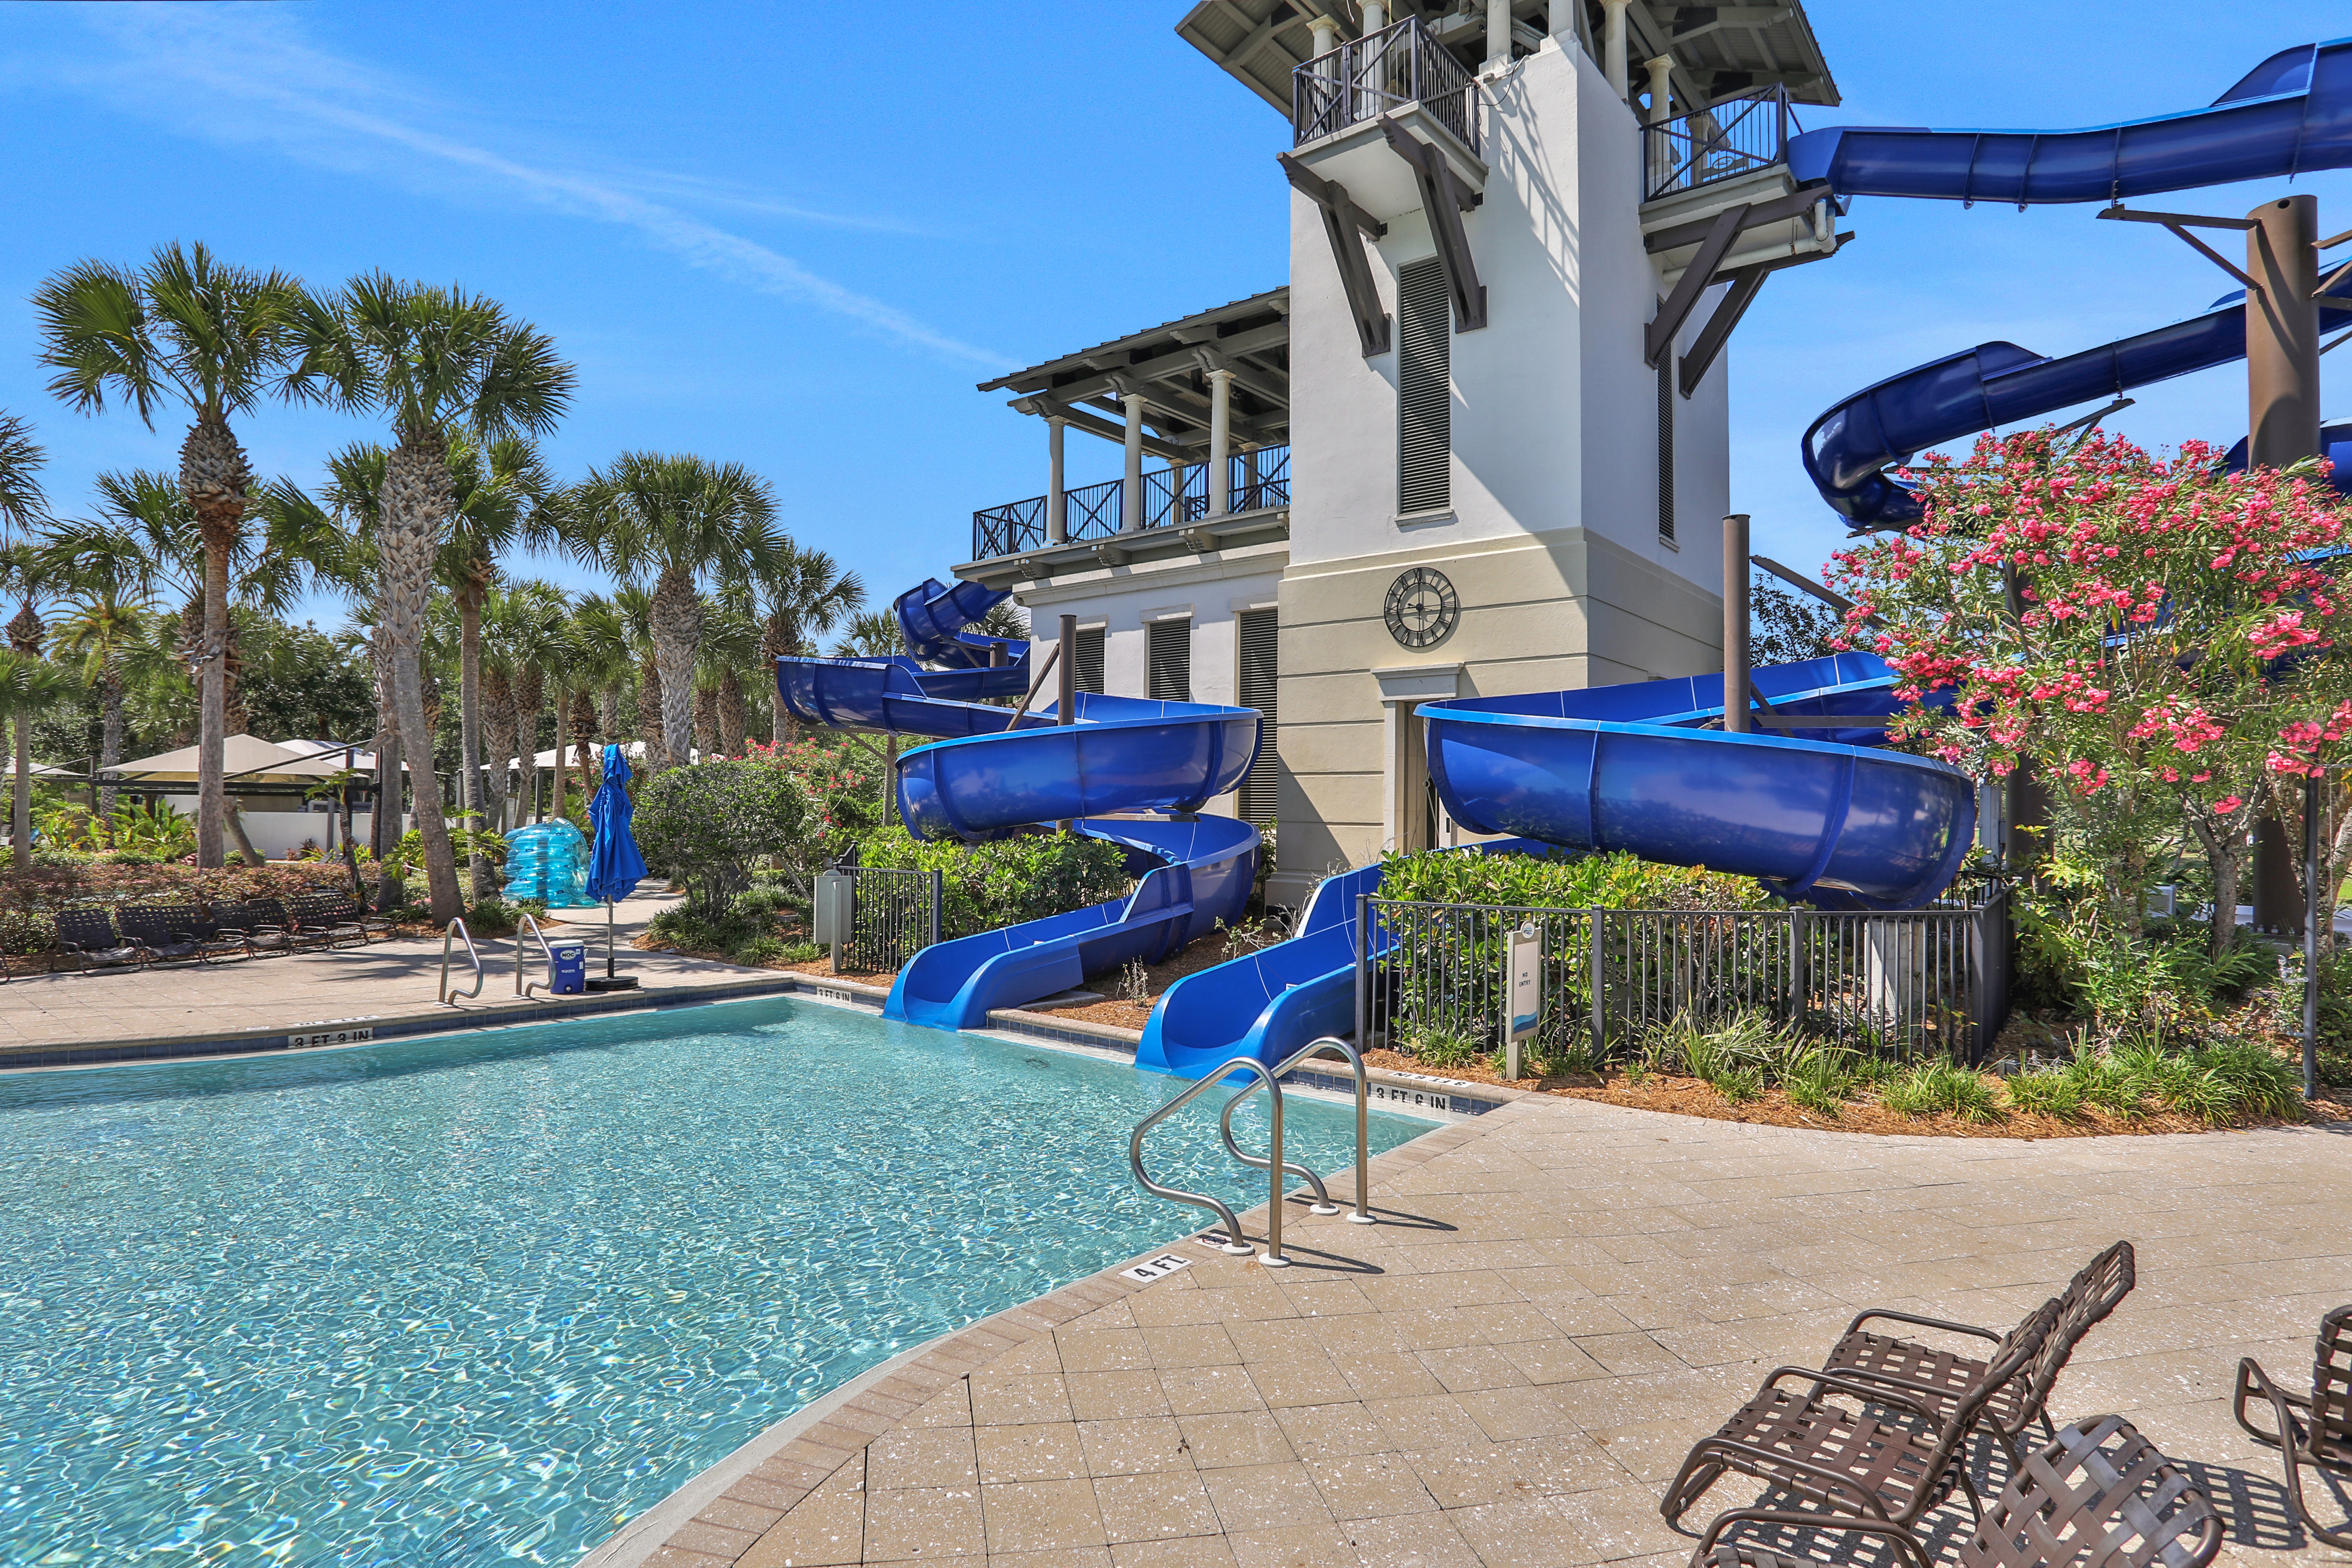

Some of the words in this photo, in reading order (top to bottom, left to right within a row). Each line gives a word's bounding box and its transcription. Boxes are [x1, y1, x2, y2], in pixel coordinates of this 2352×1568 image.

[825, 989, 832, 998] FT
[842, 992, 850, 1001] IN
[295, 1037, 304, 1047] 3
[311, 1034, 330, 1047] FT
[338, 1033, 346, 1042] 3
[353, 1030, 369, 1041] IN
[1376, 1087, 1385, 1099] 3
[1391, 1089, 1408, 1102] FT
[1416, 1093, 1424, 1105] 6
[1430, 1096, 1446, 1109] IN
[1133, 1268, 1158, 1277] 4
[1149, 1255, 1188, 1270] FT.
